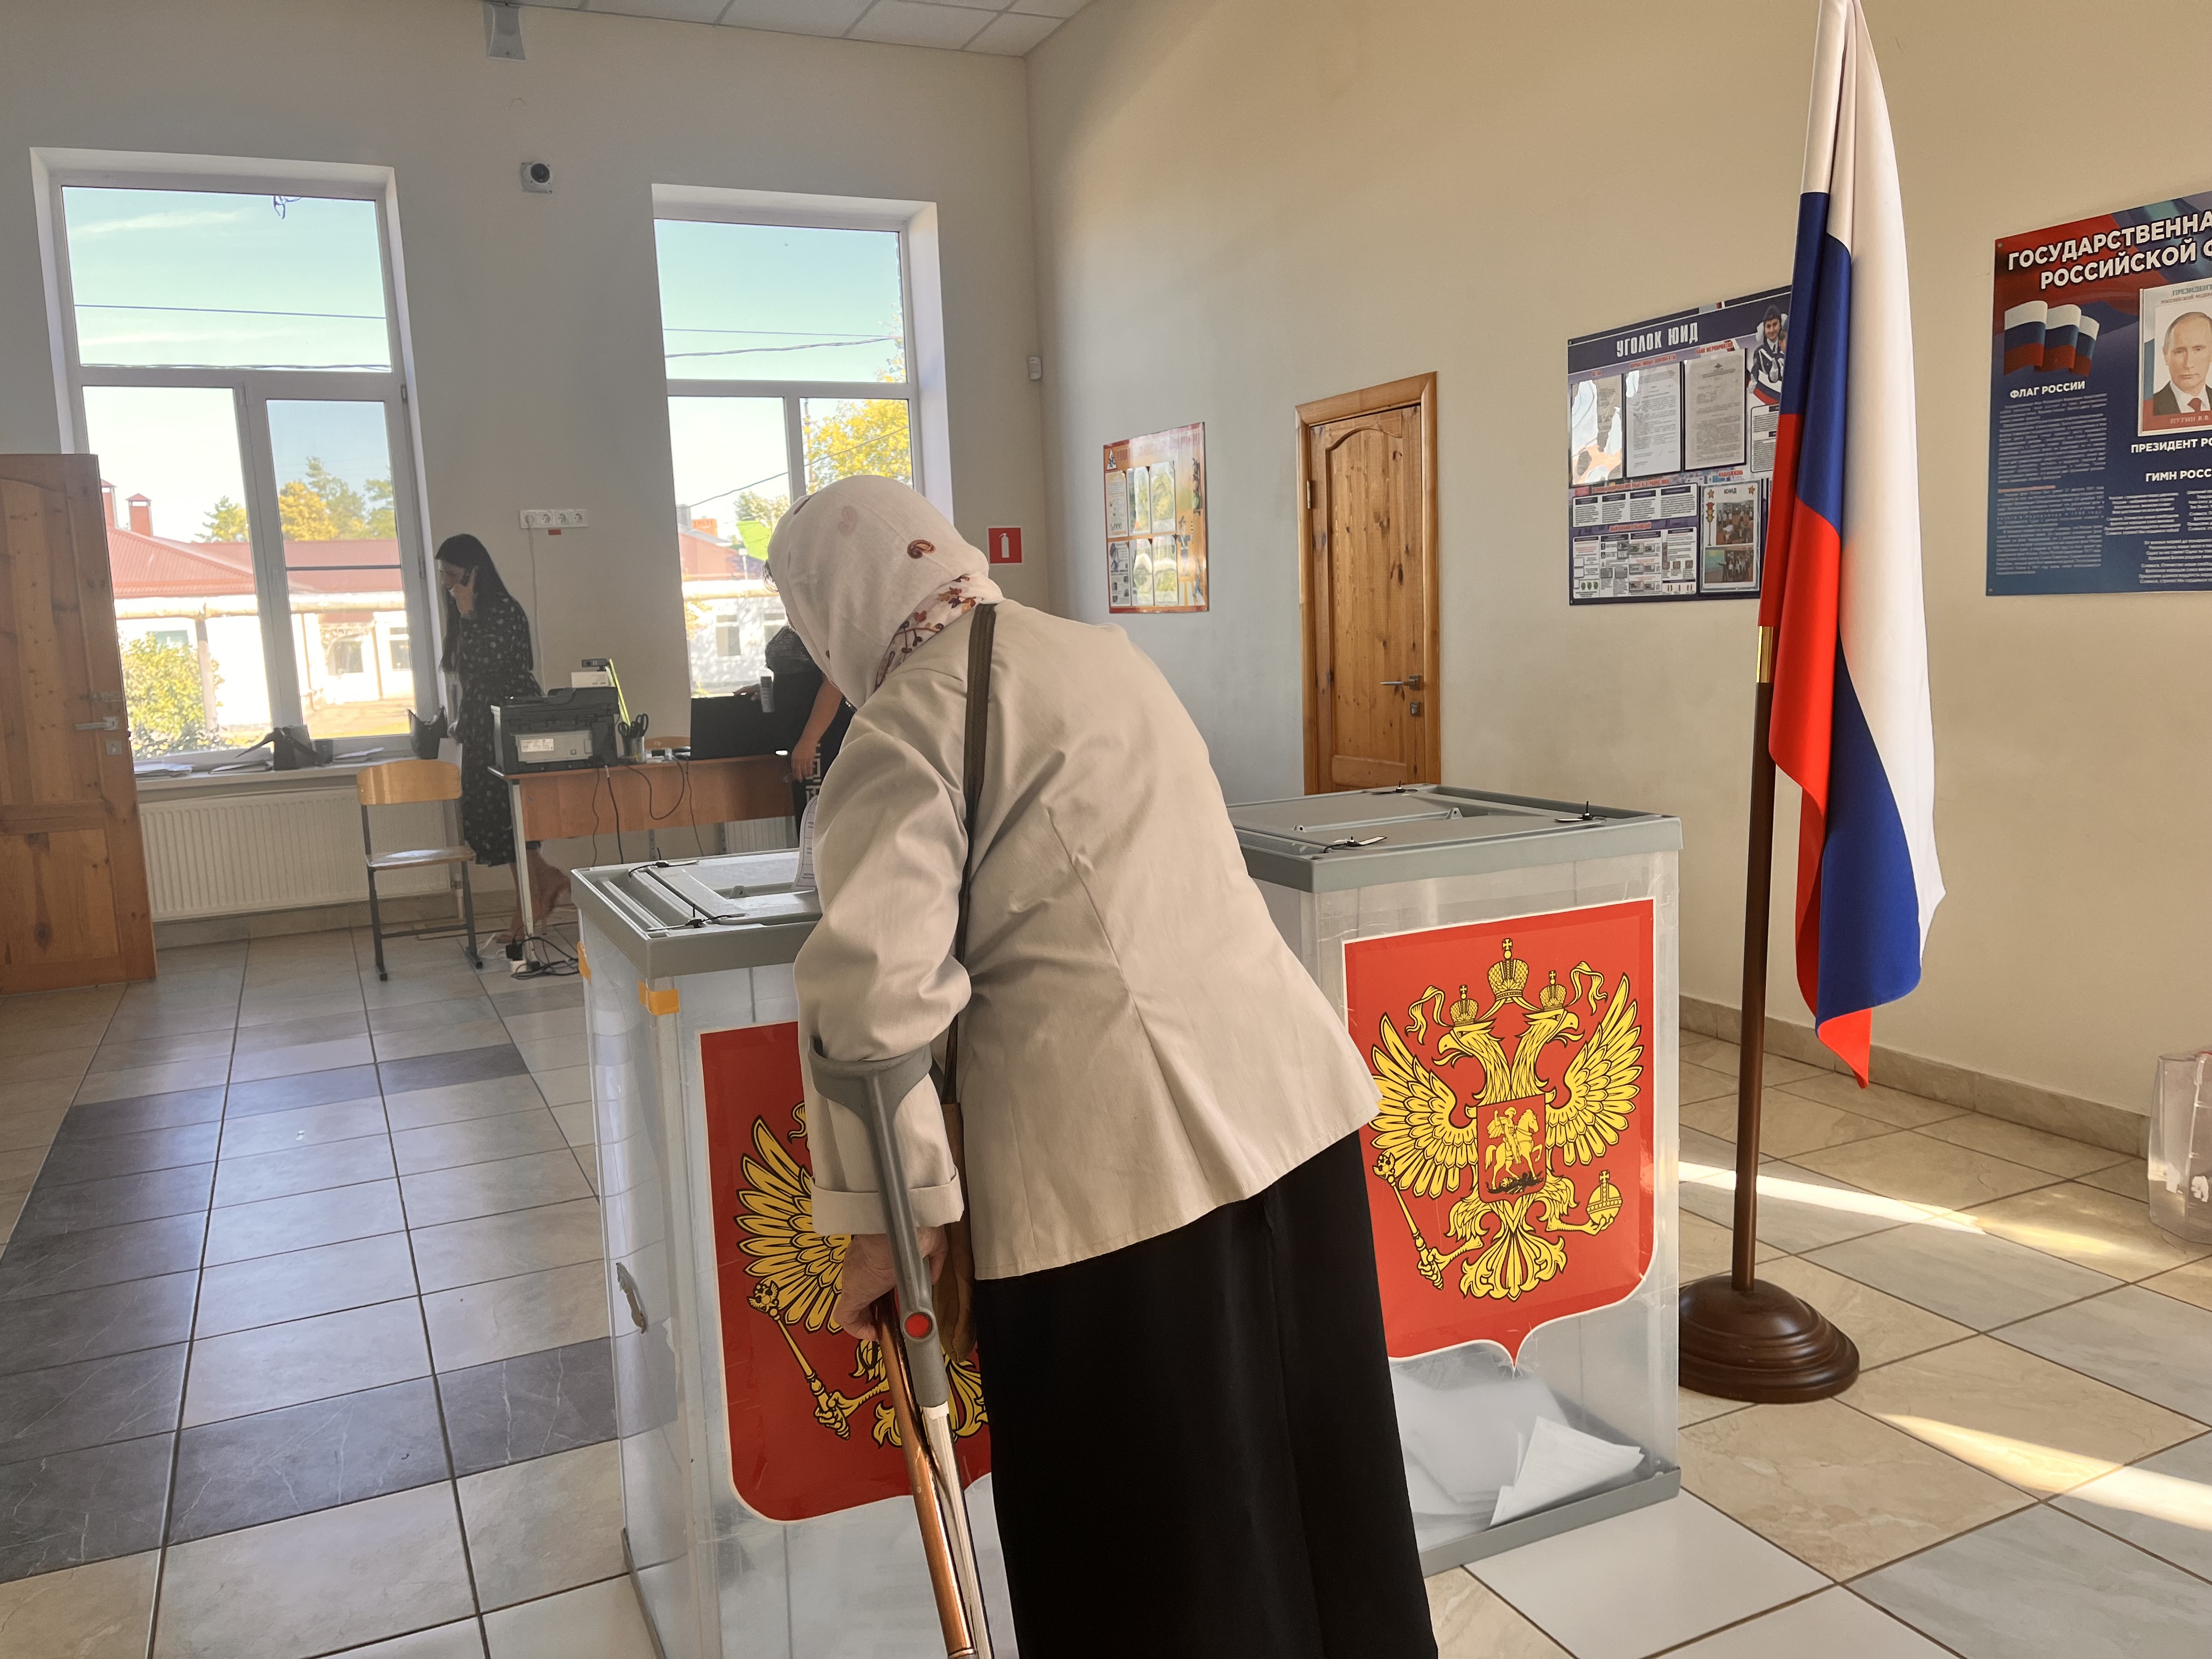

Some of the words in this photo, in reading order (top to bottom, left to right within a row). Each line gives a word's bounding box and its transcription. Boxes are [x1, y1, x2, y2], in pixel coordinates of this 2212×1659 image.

[2008, 211, 2212, 270] ГОСУДАРСТВЕННА
[2041, 238, 2196, 290] РОССИЙСКОЙ
[1616, 330, 1662, 357] УГОЛОК
[1668, 322, 1699, 345] ЮИД
[2010, 387, 2040, 398] ФЛАГ
[2041, 381, 2085, 394] РОССИИ
[2131, 438, 2198, 453] ПРЕЗИДЕНТ
[2146, 471, 2177, 482] ГИМН
